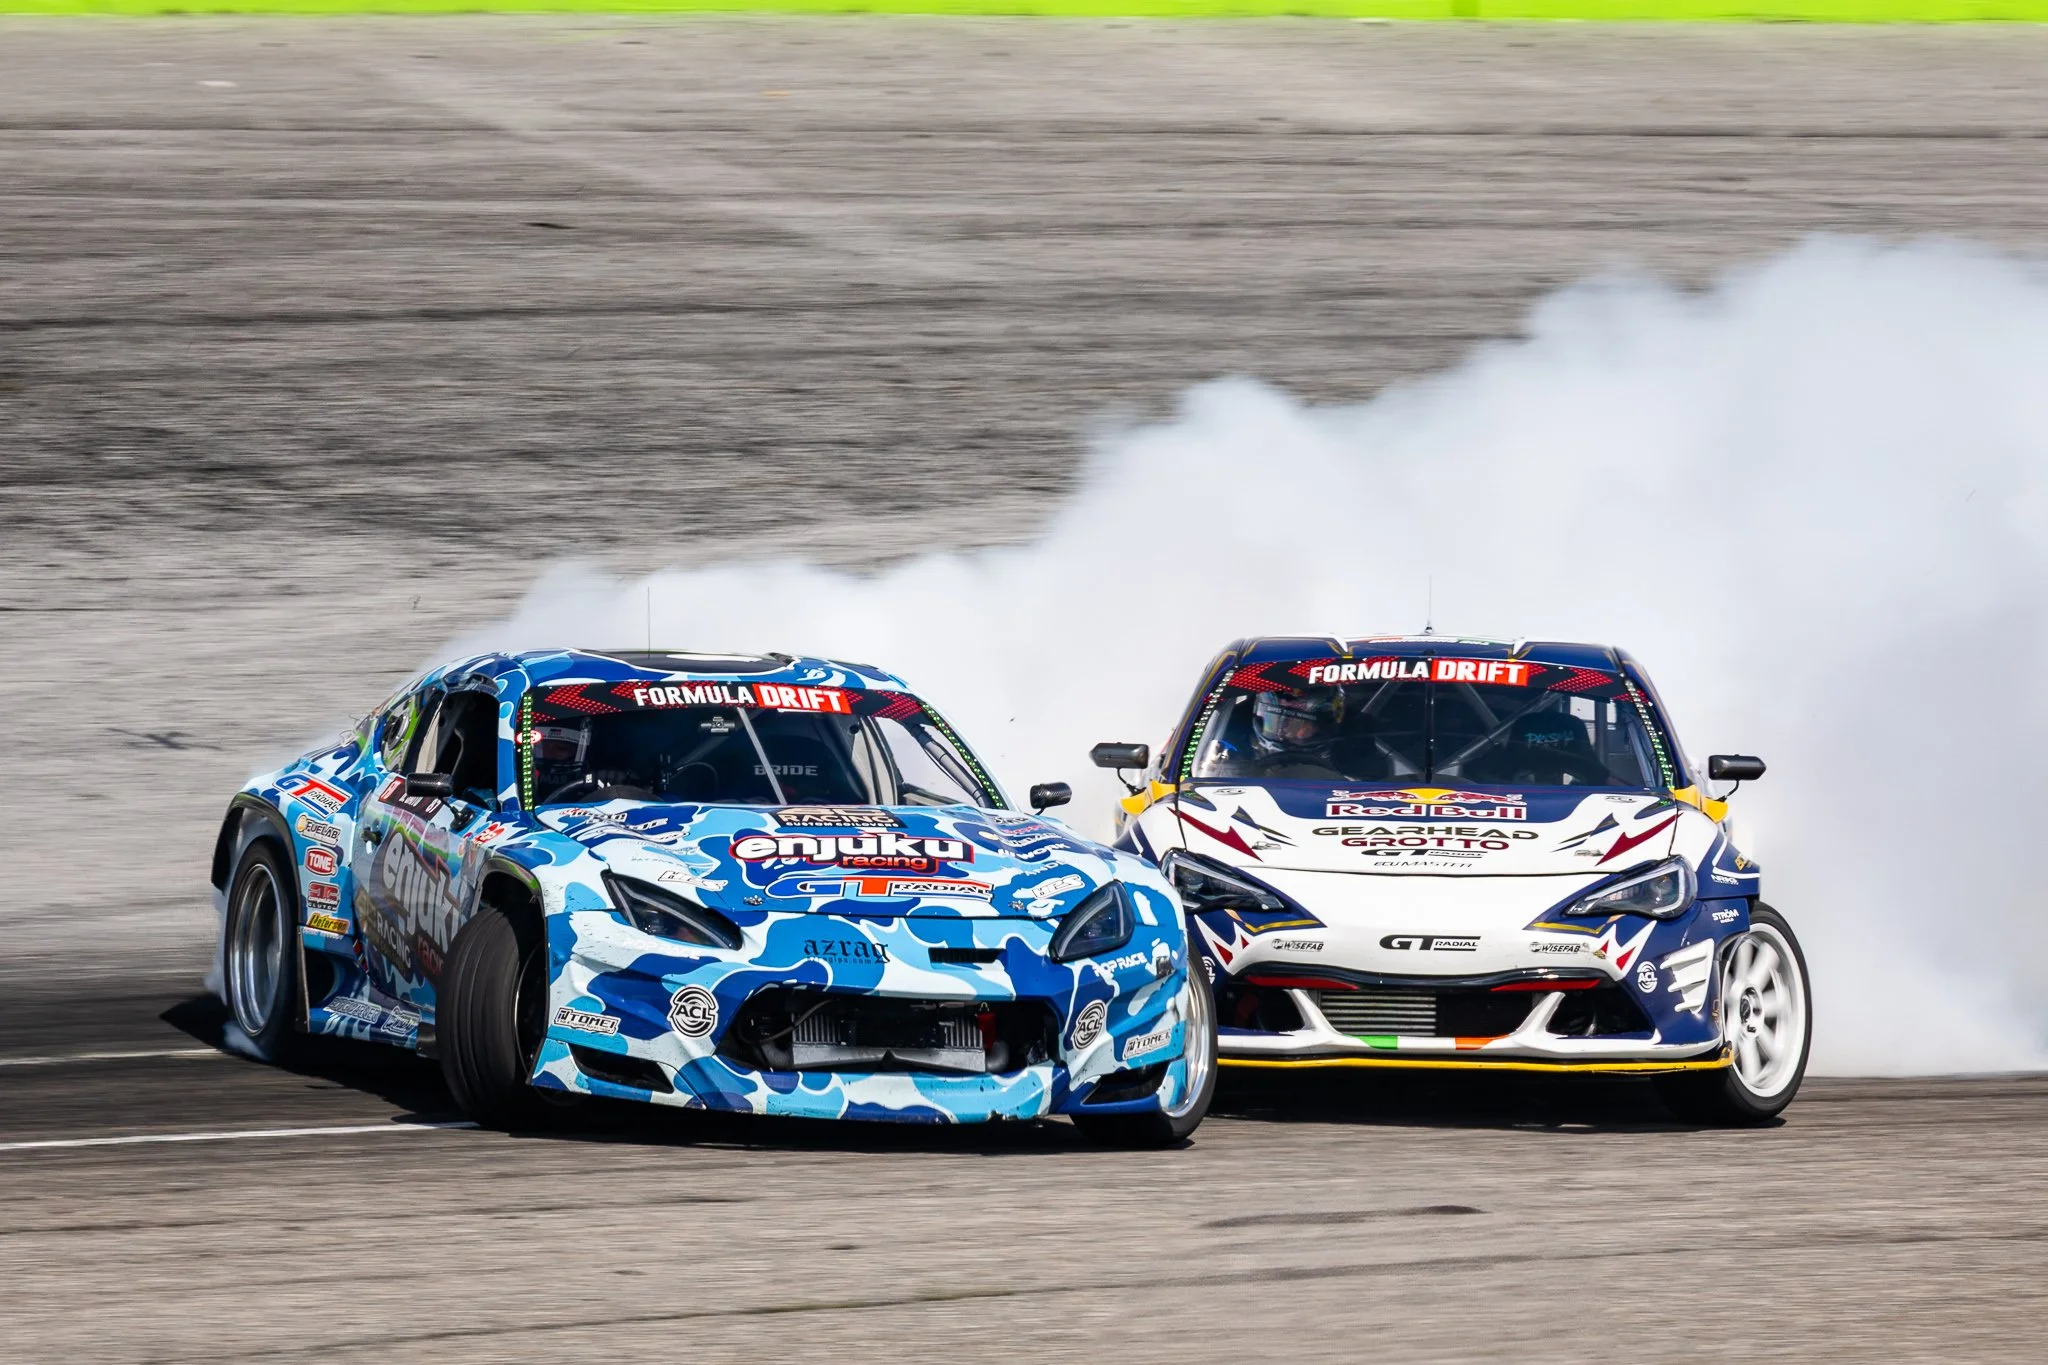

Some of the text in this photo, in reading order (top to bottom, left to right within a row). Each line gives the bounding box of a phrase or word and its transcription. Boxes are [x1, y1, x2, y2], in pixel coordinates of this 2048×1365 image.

[1309, 661, 1524, 685] FORMULA DRIFT
[633, 685, 841, 711] FORMULA DRIFT
[754, 765, 818, 776] BRIDE
[307, 790, 338, 811] RADIAL
[777, 815, 890, 824] RACING
[1326, 803, 1527, 820] Red Bull
[306, 822, 339, 839] FUELAB
[1312, 826, 1539, 840] GEARHEAD
[735, 833, 965, 861] enjuku
[1019, 843, 1071, 860] WORK
[1341, 837, 1510, 850] GROTTO
[1361, 848, 1432, 856] GT
[309, 853, 333, 871] TONE
[842, 855, 928, 870] racing
[766, 876, 991, 899] GT RADIAL
[308, 902, 337, 911] CLUTCH
[376, 911, 411, 969] RACING
[1284, 942, 1325, 951] WISEFAB
[1379, 935, 1440, 950] GT
[1541, 943, 1581, 953] WISEFAB
[1092, 952, 1148, 977] POP RACE
[1639, 972, 1658, 982] ACL
[567, 1013, 616, 1029] TOMEI
[675, 1005, 712, 1021] ACL
[1078, 1019, 1102, 1033] ACL
[1136, 1031, 1171, 1048] TOMEI
